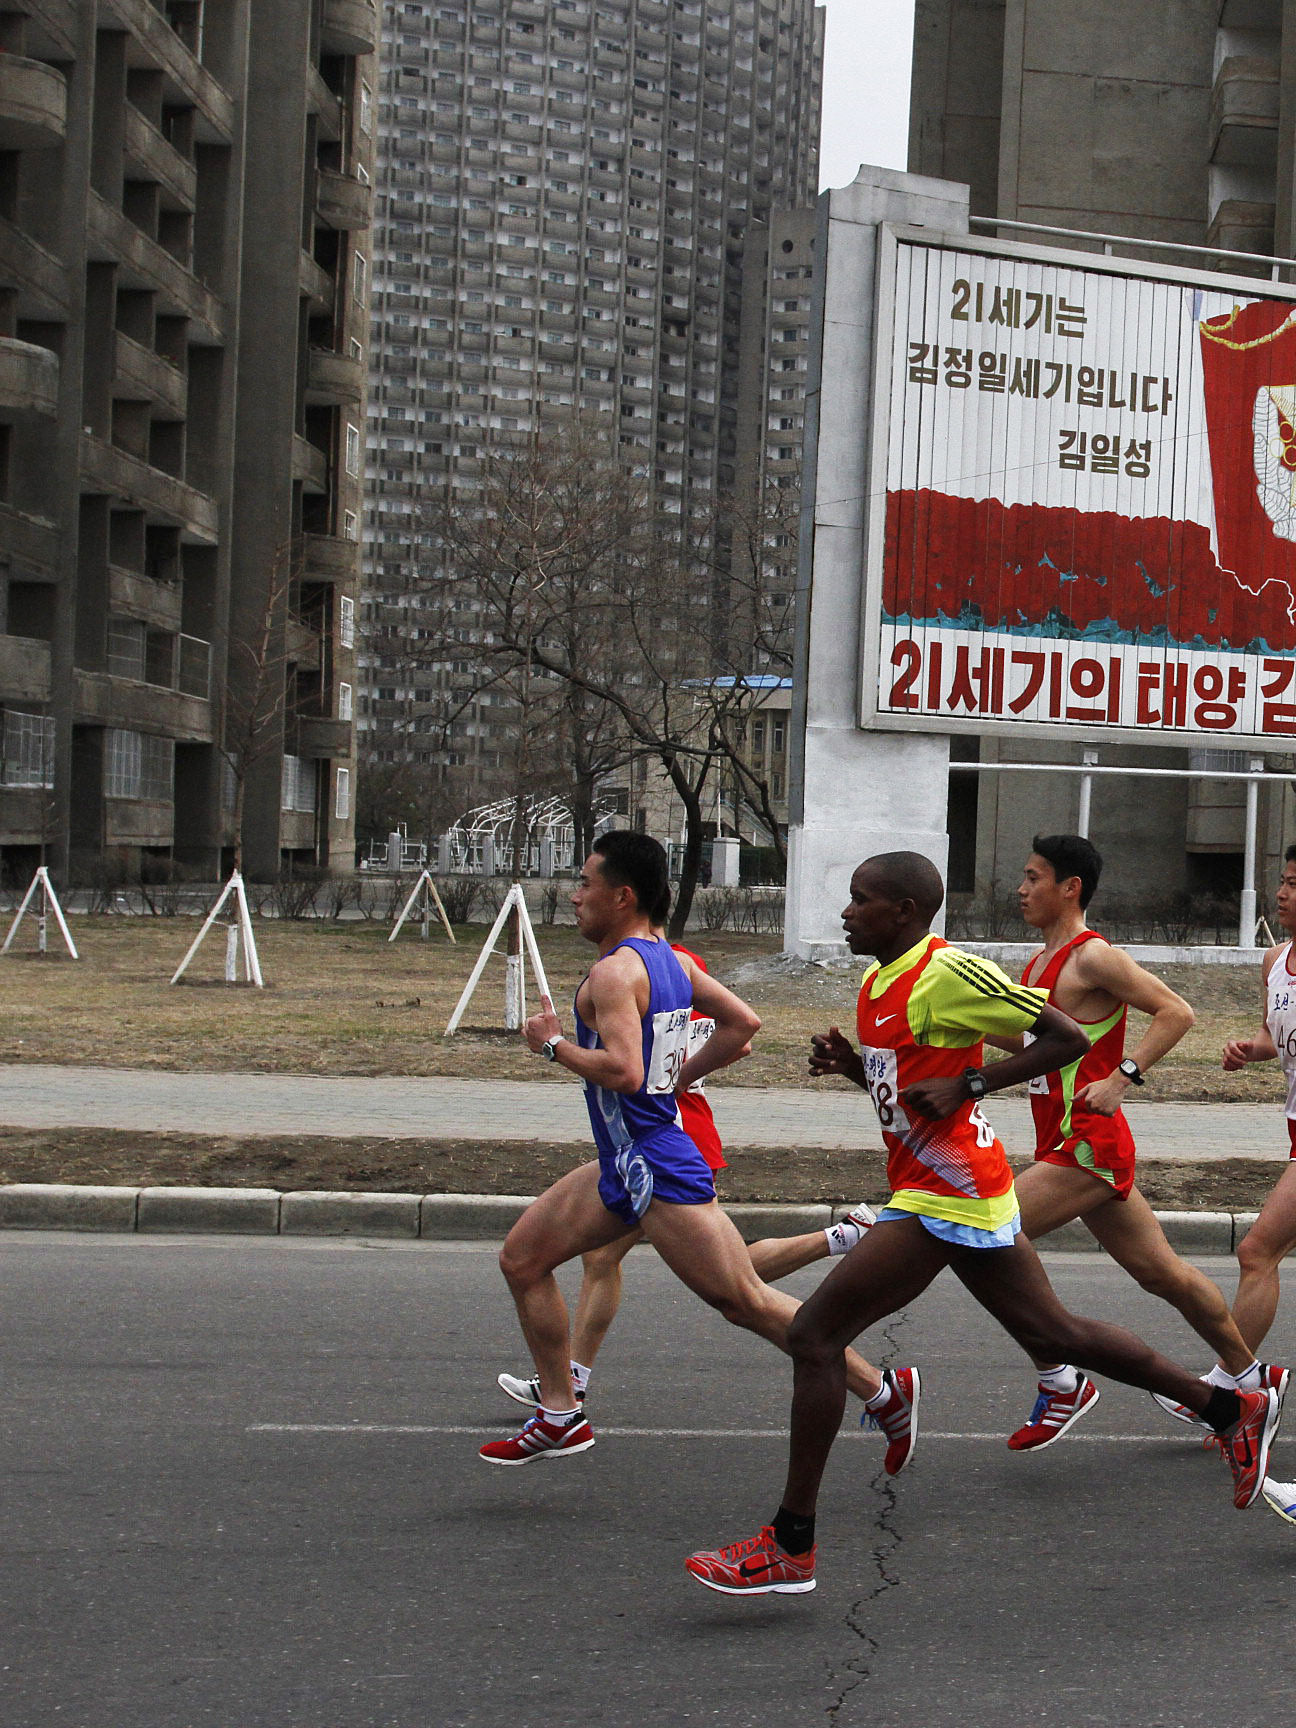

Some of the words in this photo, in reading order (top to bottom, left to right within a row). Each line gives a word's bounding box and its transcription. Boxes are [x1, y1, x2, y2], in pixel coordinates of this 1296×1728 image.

[950, 278, 1088, 339] 21세기는
[908, 342, 1173, 416] 김정일세기입니다
[1058, 429, 1152, 478] 김일성
[889, 639, 1121, 723] 21세기의
[1136, 662, 1246, 729] 태양
